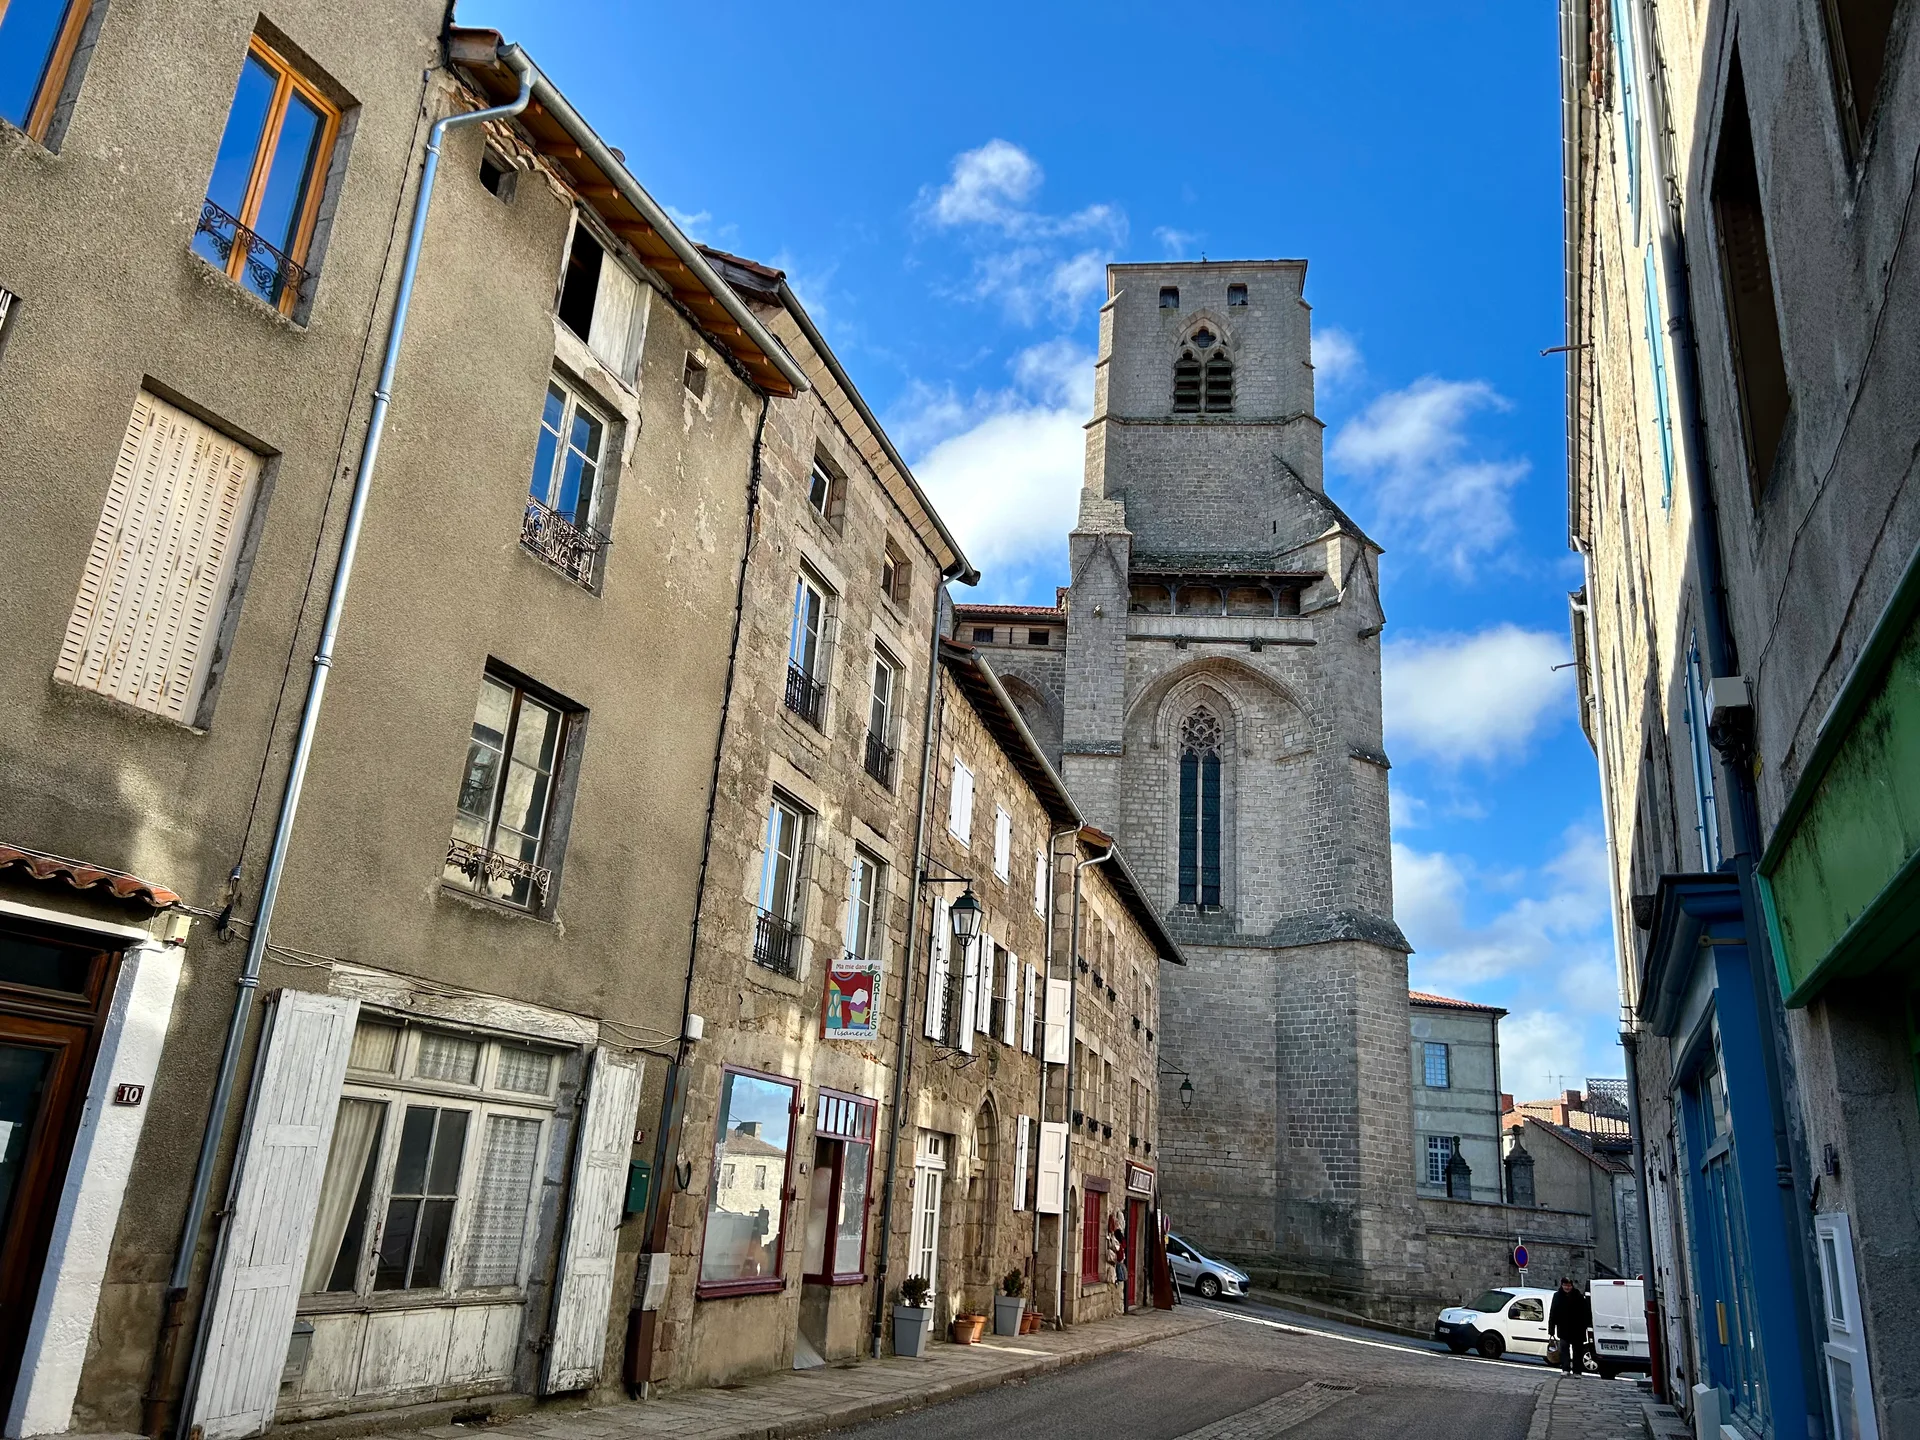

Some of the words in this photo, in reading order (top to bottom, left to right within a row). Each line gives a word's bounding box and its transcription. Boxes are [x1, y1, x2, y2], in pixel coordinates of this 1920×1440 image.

[833, 1028, 874, 1037] Tisanerie
[123, 1087, 139, 1102] 10
[636, 1130, 642, 1141] 8
